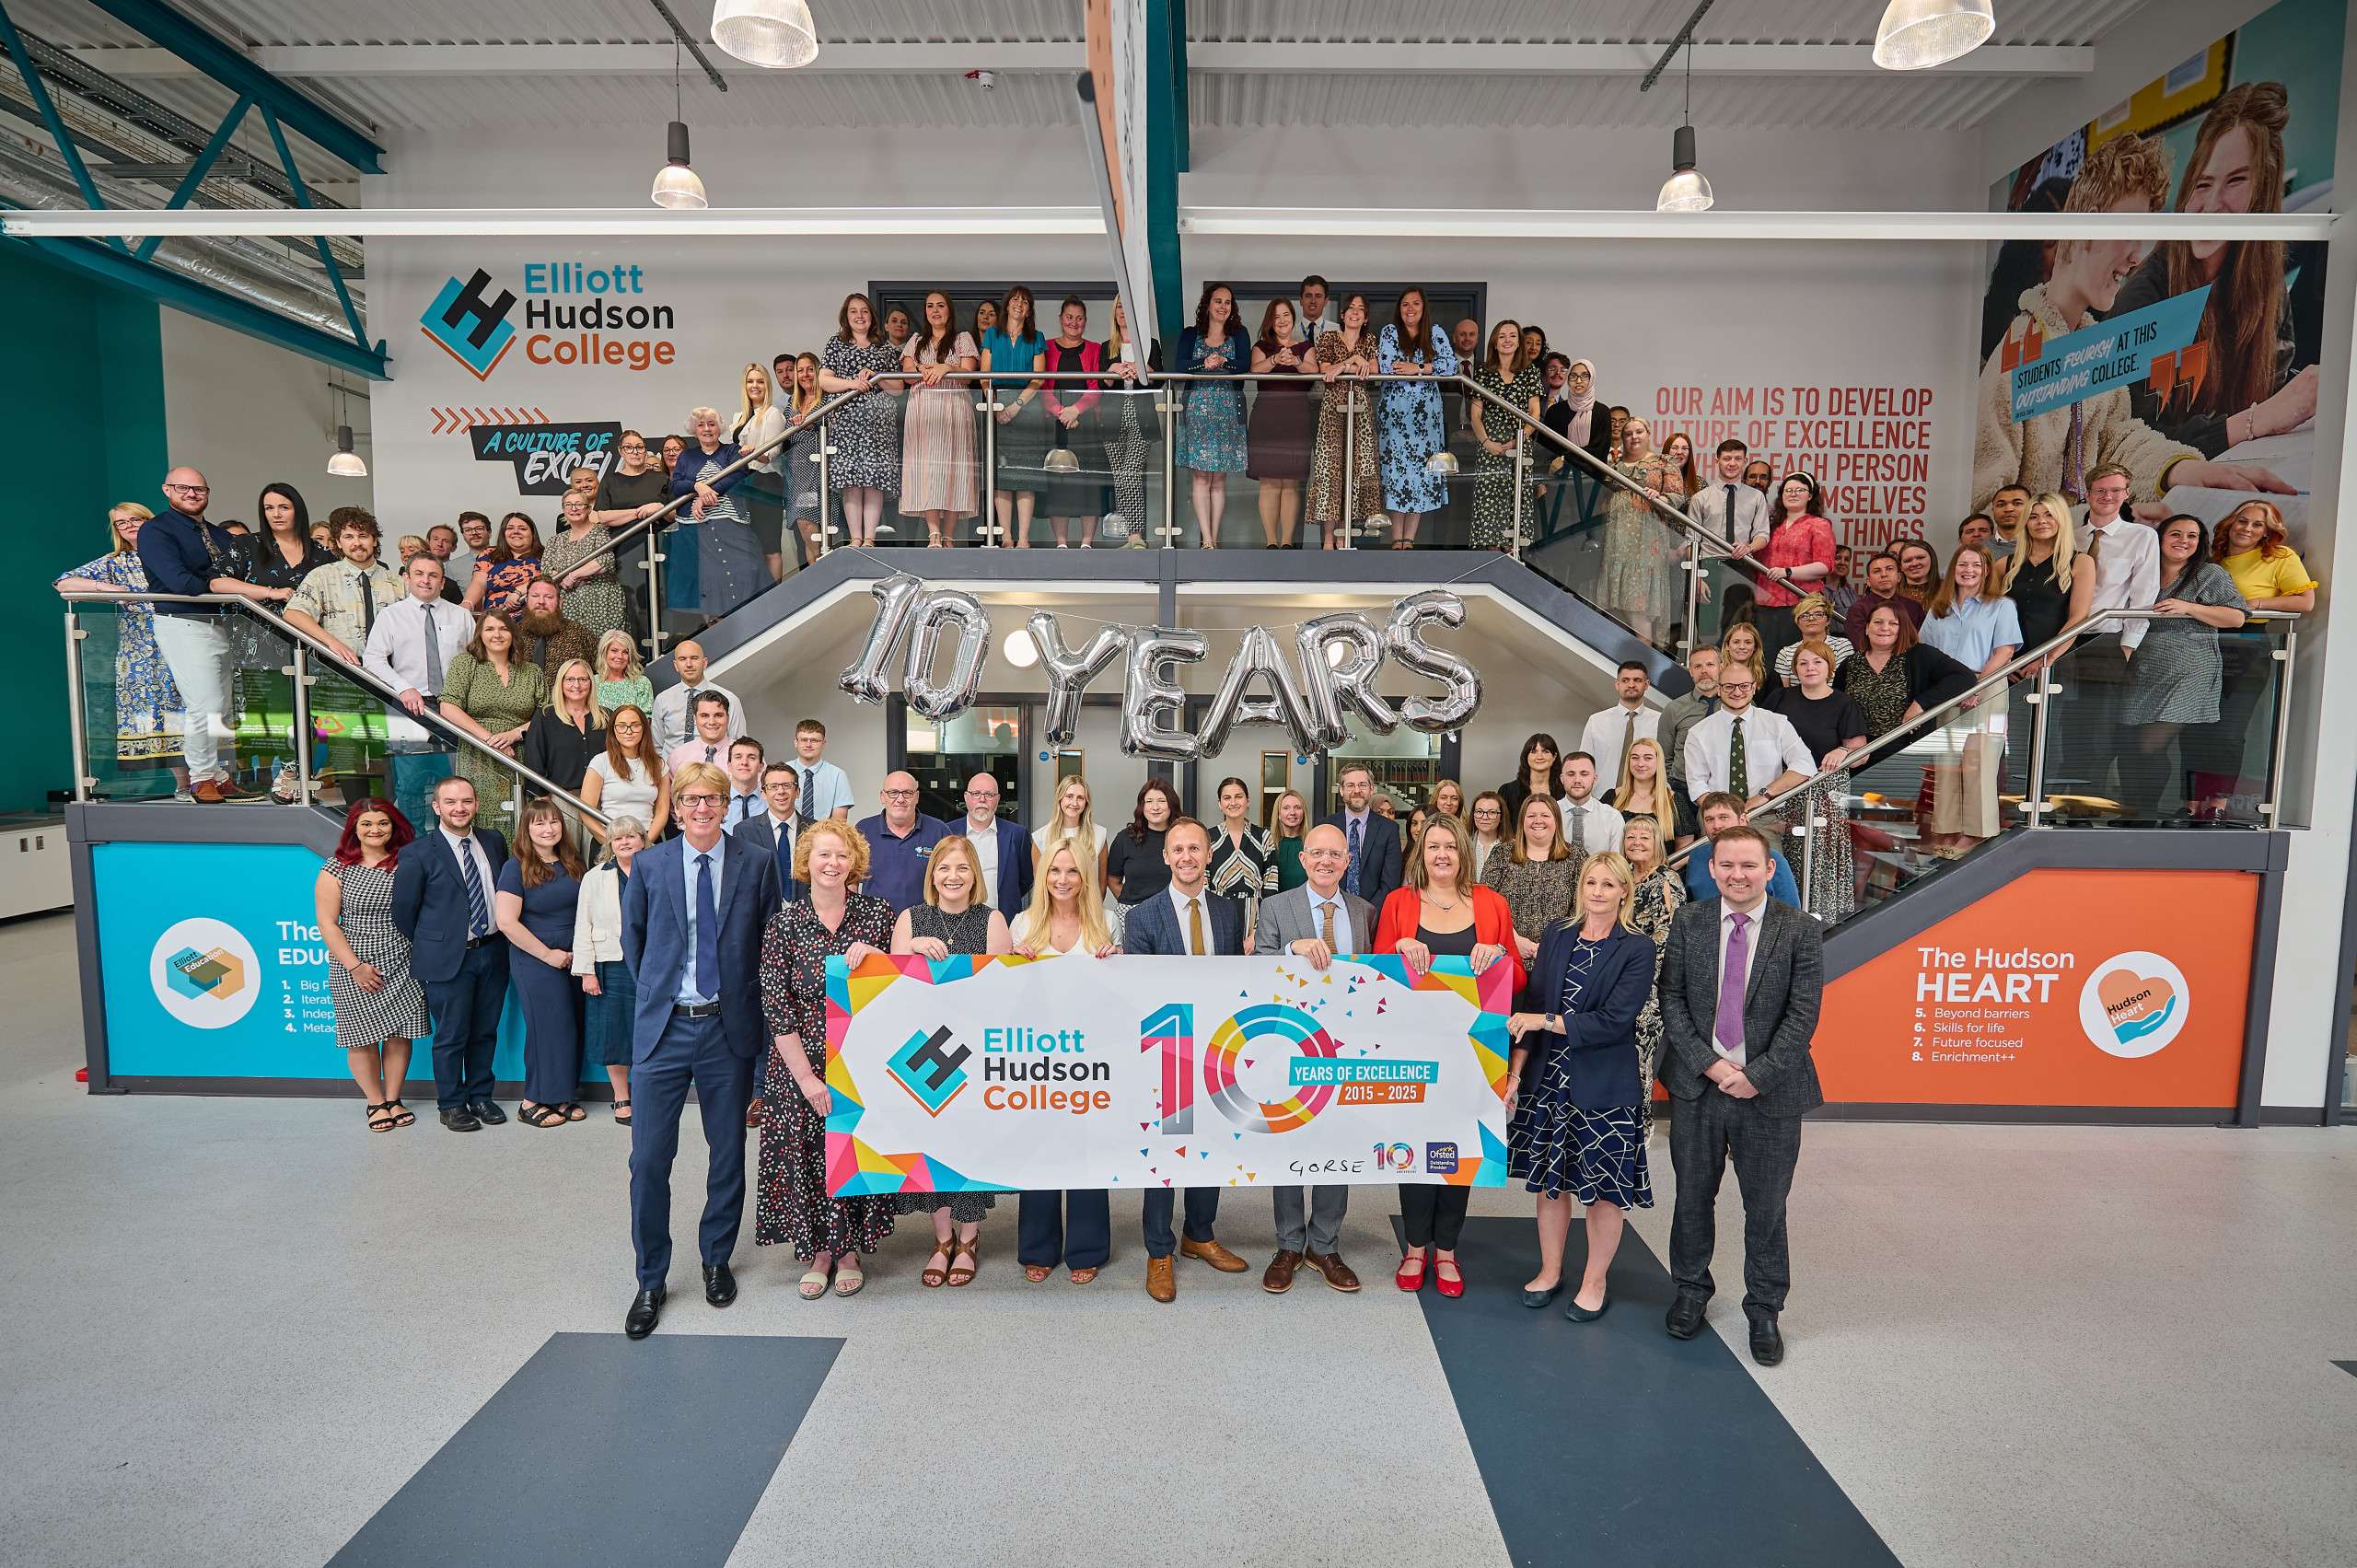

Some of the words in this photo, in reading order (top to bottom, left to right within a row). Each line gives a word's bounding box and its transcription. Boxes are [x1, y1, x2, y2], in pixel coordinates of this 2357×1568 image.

[524, 262, 644, 294] Elliott
[526, 298, 674, 329] Hudson
[526, 333, 676, 371] College
[2018, 358, 2061, 389] STUDENTS
[2064, 336, 2115, 372] FLOURISH
[2117, 331, 2130, 353] AT
[2133, 321, 2158, 346] THIS
[2016, 369, 2090, 410] OUTSTANDING
[2092, 354, 2140, 385] COLLEGE.
[1656, 387, 1703, 415] OUR
[1710, 387, 1754, 415] AIM
[1763, 387, 1785, 415] IS
[1792, 387, 1820, 415] TO
[1829, 388, 1933, 416] DEVELOP
[483, 431, 502, 454] A
[505, 431, 584, 453] CULTURE
[586, 432, 614, 453] OF
[1653, 420, 1740, 448] UTURE
[1747, 420, 1776, 448] OF
[1784, 421, 1931, 449] EXCELLENCE
[1771, 454, 1828, 482] EACH
[1836, 454, 1928, 482] PERSON
[1840, 518, 1924, 546] THINGS
[840, 571, 993, 726] 10
[1027, 588, 1484, 762] YEARS
[276, 921, 322, 941] The
[173, 952, 198, 968] Elliott
[184, 949, 222, 972] Education
[1918, 947, 1966, 968] The
[1975, 947, 2074, 969] Hudson
[282, 981, 290, 990] 1.
[301, 981, 319, 992] Big
[1917, 973, 2059, 1003] HEART
[283, 994, 294, 1005] 2.
[2107, 990, 2151, 1015] Hudson
[284, 1008, 295, 1018] 3.
[302, 1009, 335, 1020] Indep
[1915, 1008, 1926, 1017] 5.
[1934, 1008, 1980, 1020] Beyond
[1984, 1008, 2030, 1018] barriers
[2110, 1003, 2143, 1023] Heart
[284, 1023, 296, 1032] 4.
[1914, 1023, 1925, 1032] 6.
[1933, 1023, 1963, 1033] Skills
[1967, 1023, 1984, 1032] for
[1987, 1023, 2004, 1033] life
[984, 1028, 1085, 1052] Elliott
[1913, 1038, 1922, 1047] 7.
[1933, 1038, 1971, 1048] Future
[1976, 1038, 2023, 1048] focused
[1911, 1051, 1922, 1061] 8.
[1932, 1051, 2015, 1062] Enrichment++
[984, 1056, 1109, 1081] Hudson
[1141, 1004, 1337, 1134] 10
[1295, 1066, 1333, 1081] YEARS
[1337, 1066, 1353, 1081] OF
[1356, 1065, 1430, 1080] EXCELLENCE
[983, 1085, 1110, 1114] College
[1345, 1086, 1373, 1100] 2015
[1387, 1086, 1417, 1099] 2025
[1373, 1143, 1414, 1170] 10
[1430, 1150, 1455, 1159] Ofsted
[1289, 1159, 1364, 1177] GORSE
